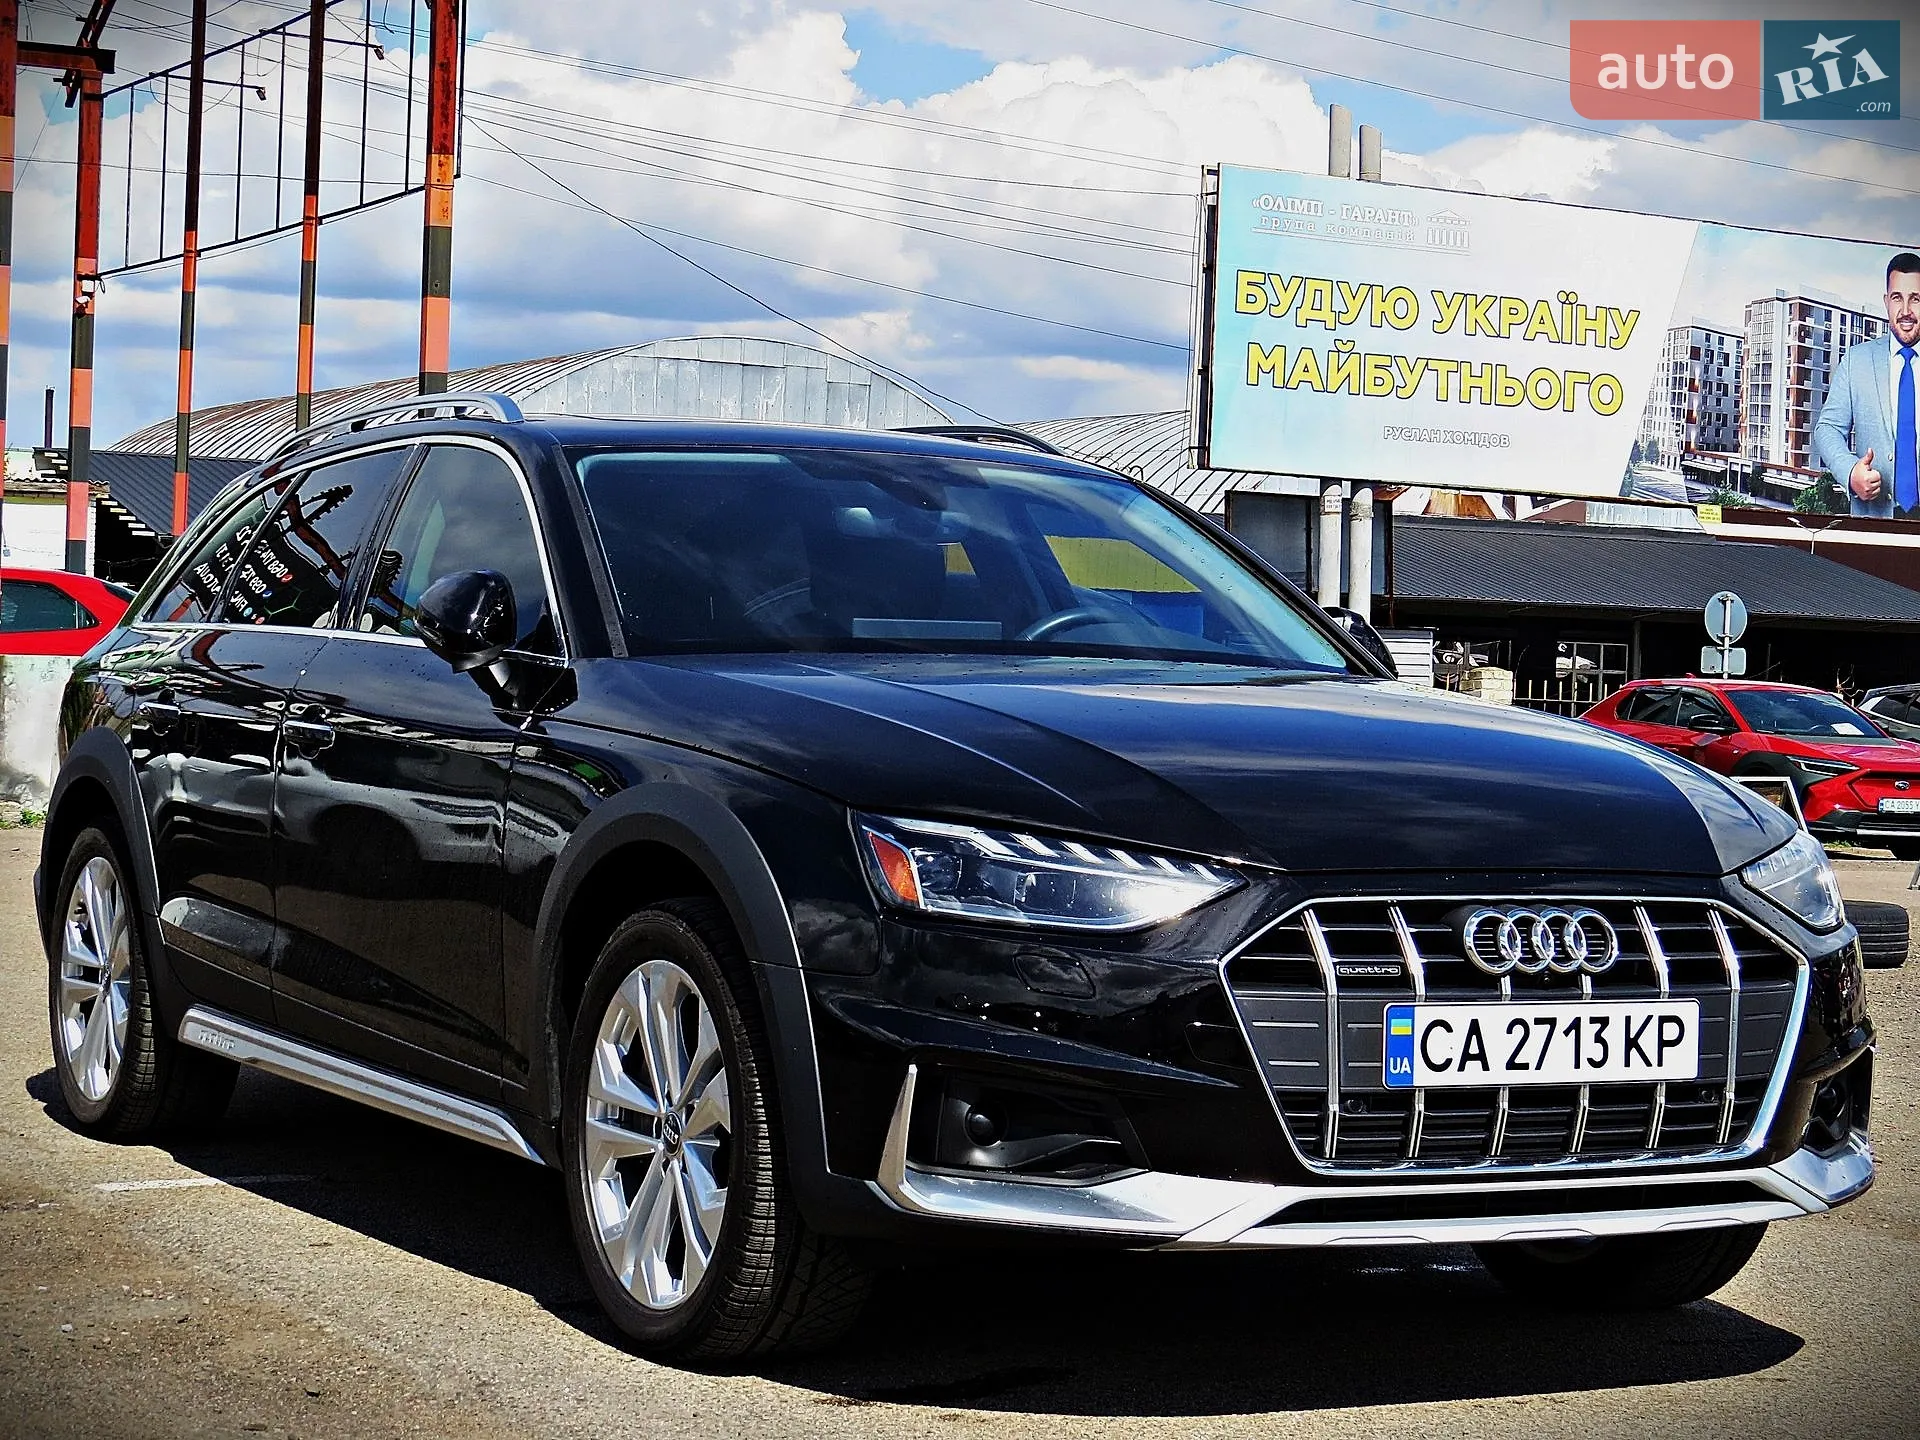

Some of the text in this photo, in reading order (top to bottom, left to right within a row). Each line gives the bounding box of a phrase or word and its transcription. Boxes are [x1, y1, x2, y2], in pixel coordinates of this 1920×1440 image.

[1260, 215, 1416, 242] група компаній
[1234, 269, 1640, 351] БУДУЮ УКРАЇНУ
[1245, 338, 1624, 416] МАЙБУТНЬОГО
[1383, 425, 1511, 448] РУСЛАН ХОМІДОВ
[1339, 966, 1399, 975] quattro
[1420, 1014, 1685, 1072] CA 2713 KP
[1389, 1056, 1412, 1074] UA
